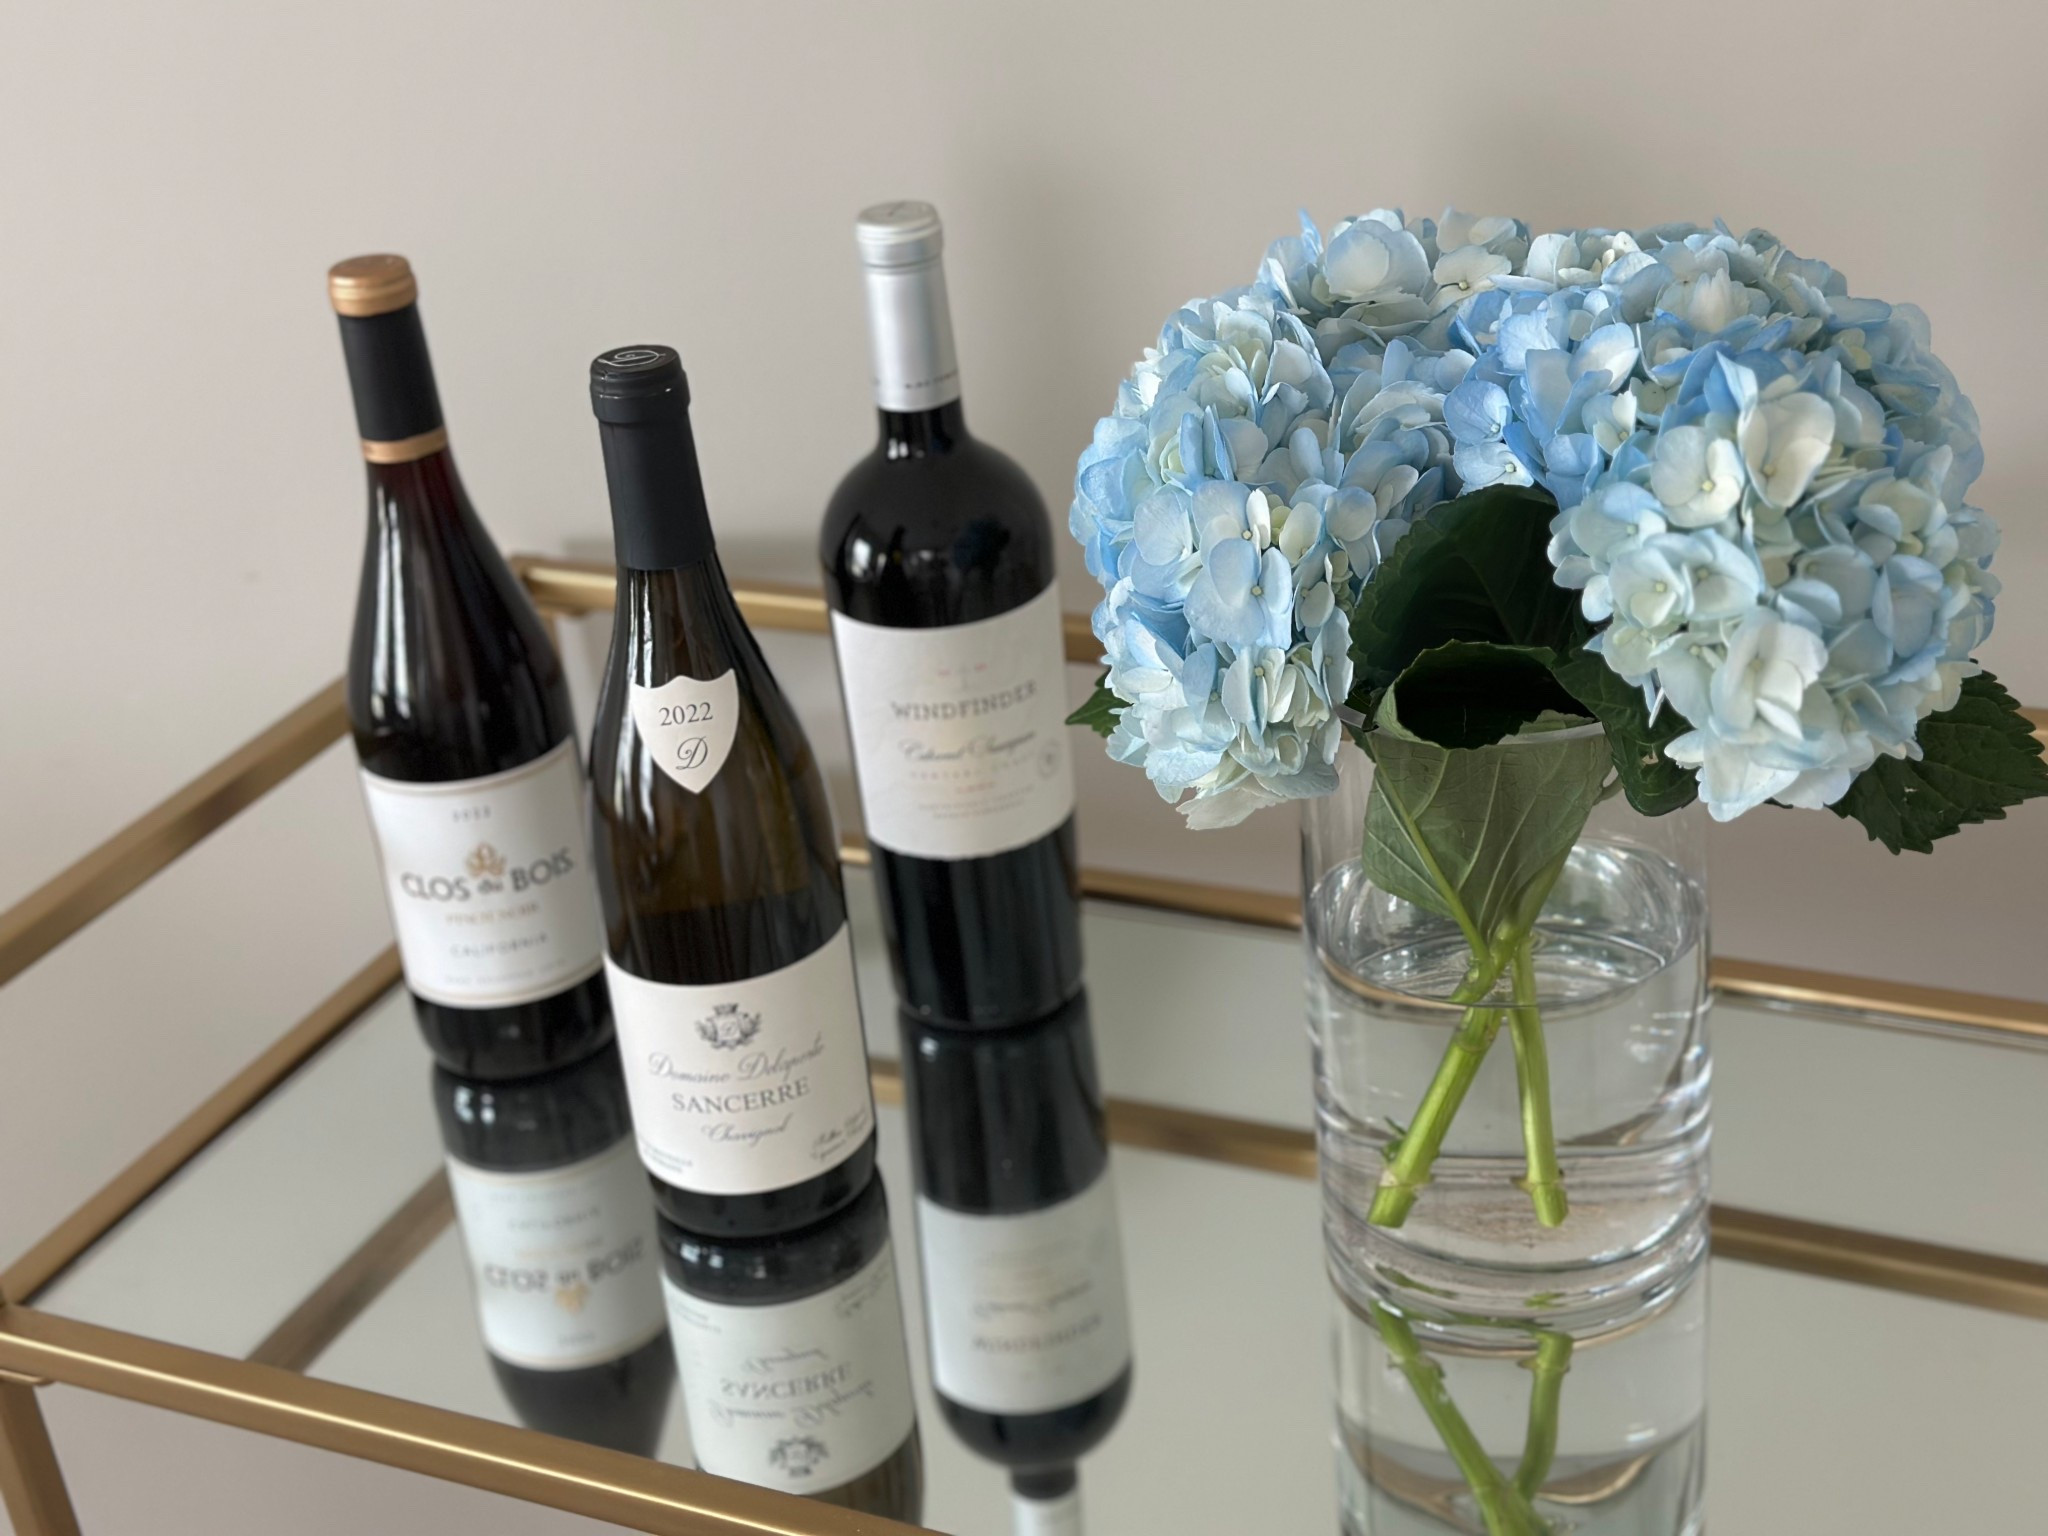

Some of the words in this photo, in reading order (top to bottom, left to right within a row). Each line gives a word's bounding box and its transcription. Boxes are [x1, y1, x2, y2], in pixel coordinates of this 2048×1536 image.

[658, 702, 713, 727] 2022
[891, 680, 1037, 720] WINDFINDER
[676, 736, 708, 771] D
[400, 871, 471, 902] CLOS
[511, 847, 574, 892] BOIS
[648, 1052, 731, 1084] Domaine
[672, 1076, 811, 1114] SANCERRE
